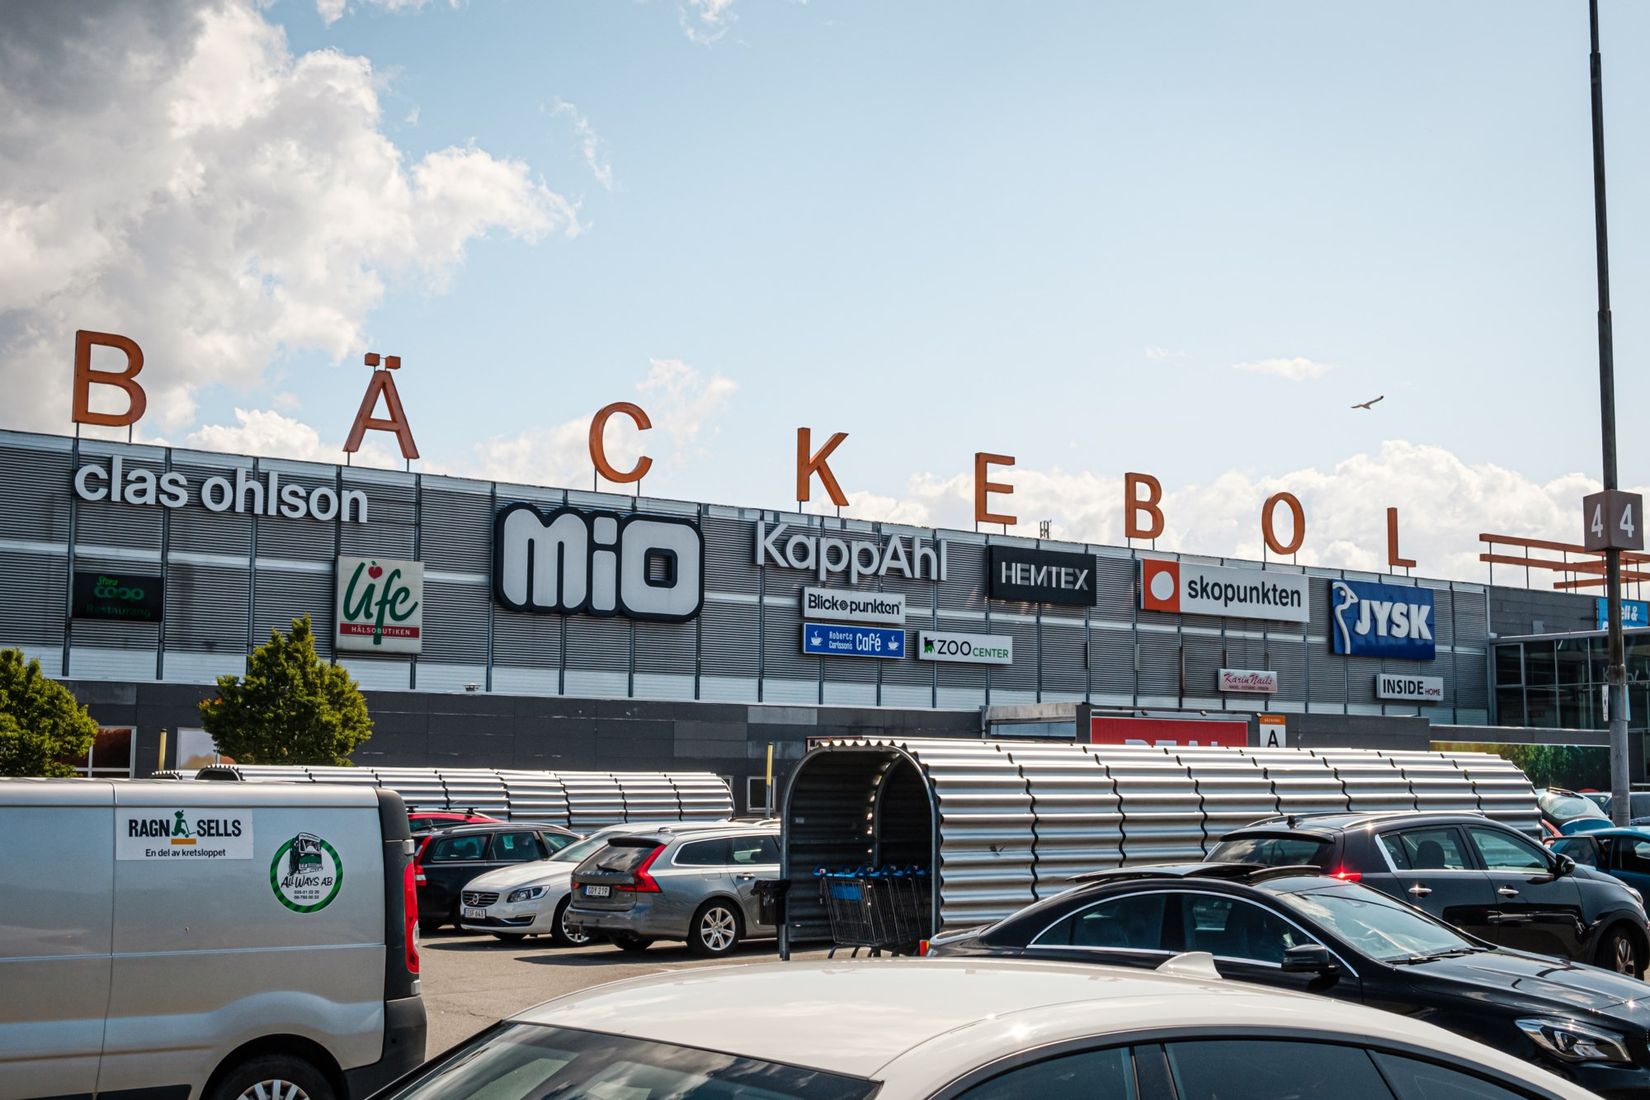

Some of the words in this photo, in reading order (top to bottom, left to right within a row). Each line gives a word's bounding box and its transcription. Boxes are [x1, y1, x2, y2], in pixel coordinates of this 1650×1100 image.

[75, 455, 189, 508] clas
[201, 467, 368, 523] ohlson
[1591, 503, 1604, 538] 4
[1620, 503, 1635, 538] 4
[755, 519, 948, 585] KappAhl
[1001, 561, 1089, 591] HEMTEX
[1187, 575, 1302, 608] skopunkten
[343, 561, 419, 646] Life
[1354, 598, 1434, 640] JYSK
[937, 639, 972, 656] ZOO
[972, 647, 1009, 658] CENTER
[1383, 679, 1424, 695] INSIDE
[1425, 688, 1441, 696] HOME
[1267, 729, 1279, 747] A
[128, 819, 170, 837] RAGN
[196, 819, 242, 837] SELLS
[145, 848, 156, 857] En
[158, 848, 170, 857] del
[181, 848, 226, 858] kretsloppet
